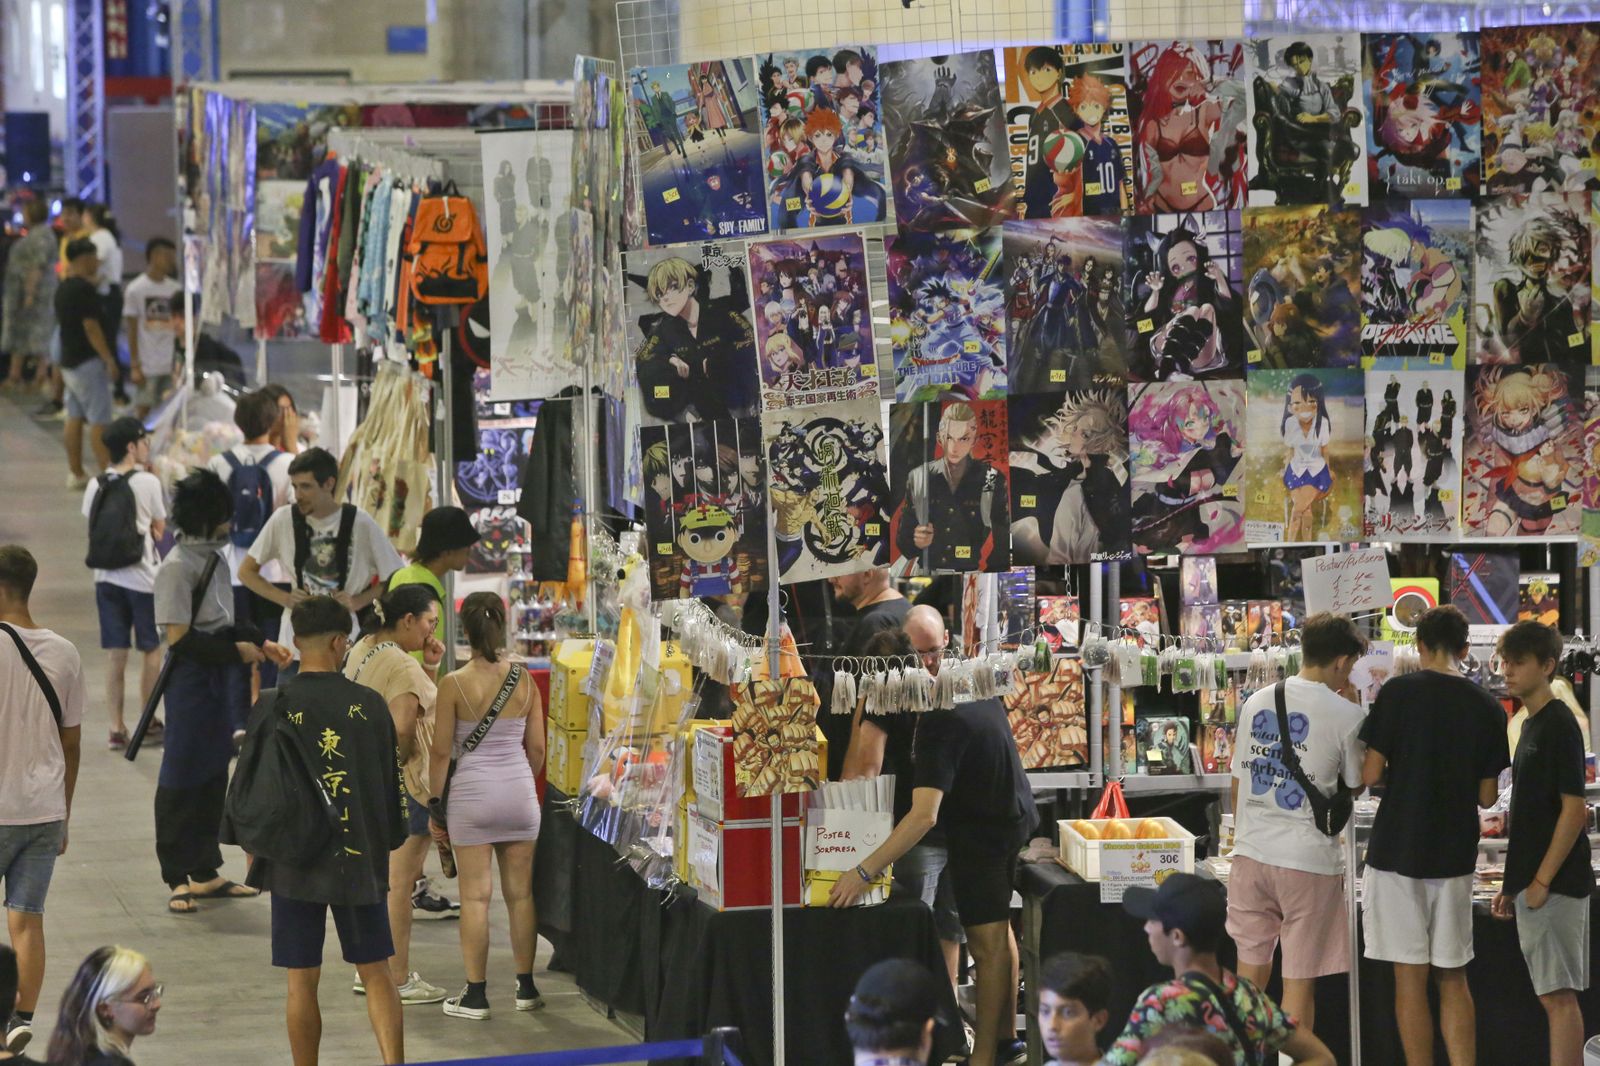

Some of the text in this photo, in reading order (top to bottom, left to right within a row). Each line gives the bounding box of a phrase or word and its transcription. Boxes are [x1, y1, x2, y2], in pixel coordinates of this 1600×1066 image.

[1096, 161, 1116, 193] 10
[718, 218, 766, 236] SPY FAMILY
[897, 366, 915, 376] THE
[816, 827, 851, 842] POSTER
[814, 845, 857, 856] SORPRESA
[1160, 854, 1179, 864] 30€
